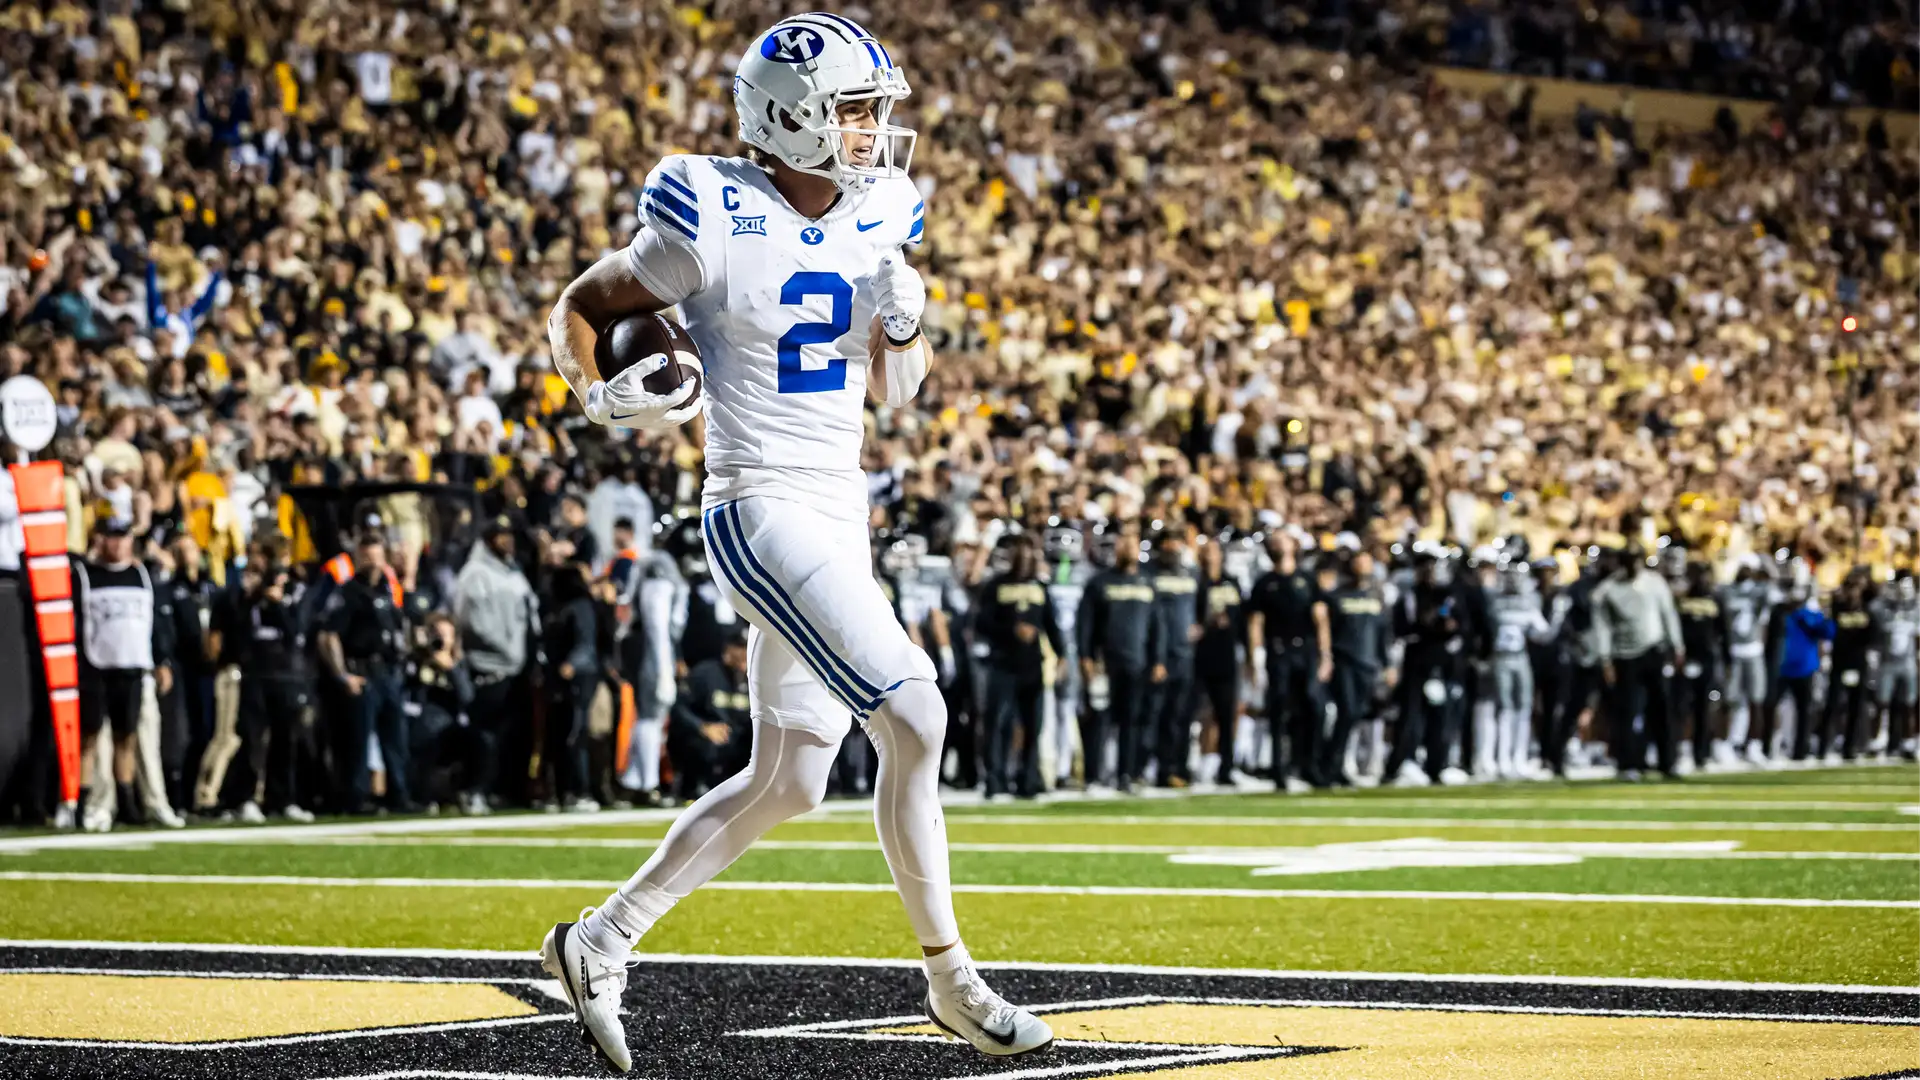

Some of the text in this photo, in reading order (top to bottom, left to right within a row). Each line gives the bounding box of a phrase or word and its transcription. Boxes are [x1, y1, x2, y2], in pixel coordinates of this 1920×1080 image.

[723, 185, 740, 212] C
[732, 215, 767, 236] XII
[803, 229, 821, 243] Y
[778, 272, 852, 393] 2
